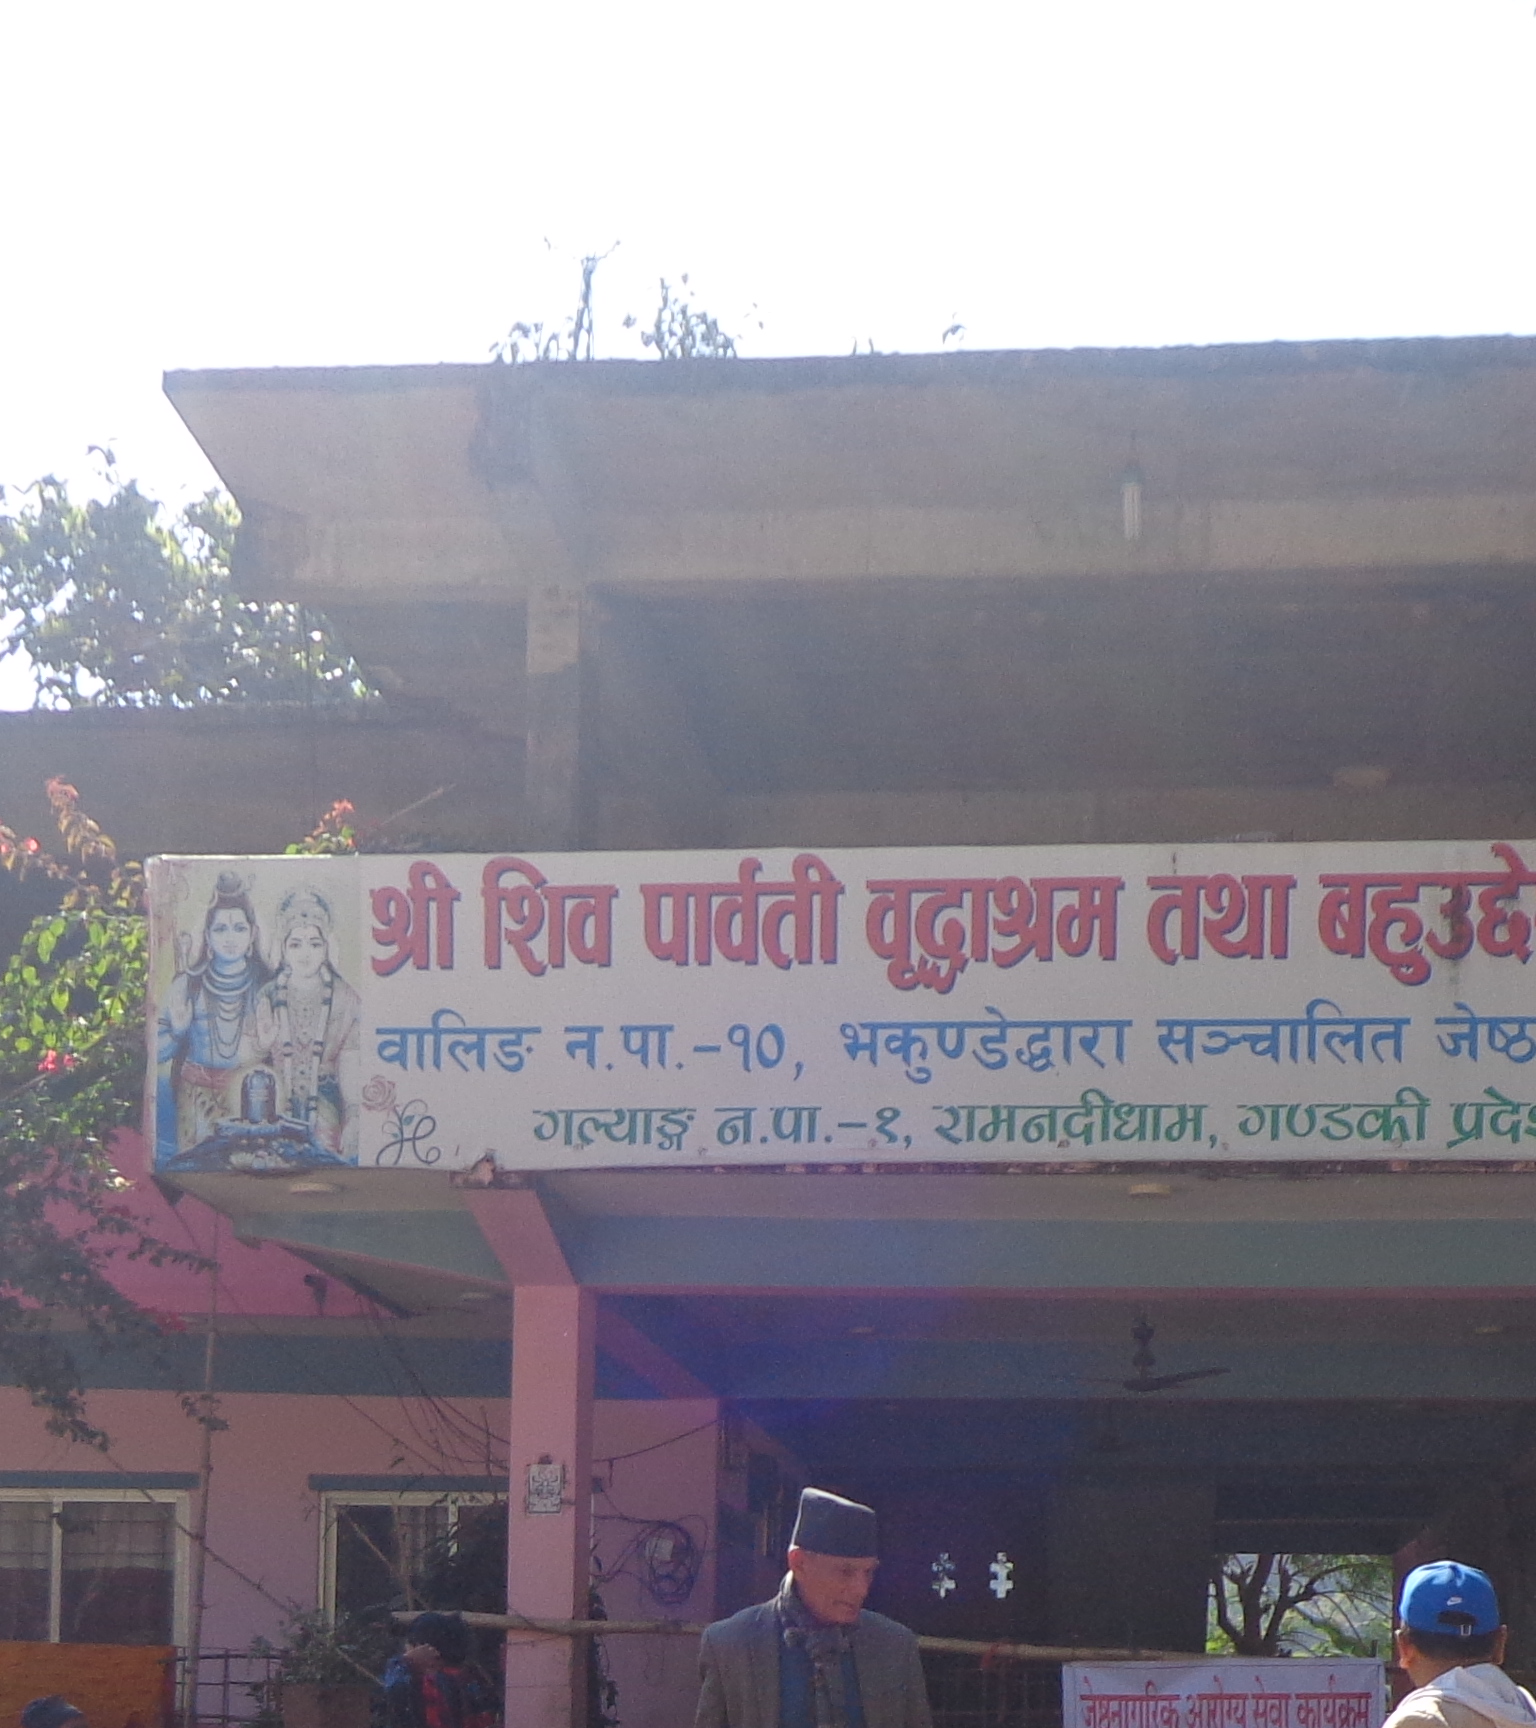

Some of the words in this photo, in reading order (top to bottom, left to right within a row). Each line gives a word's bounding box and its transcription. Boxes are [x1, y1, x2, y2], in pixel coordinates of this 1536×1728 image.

[369, 860, 461, 976] श्री
[481, 856, 619, 977] शिव
[639, 853, 845, 970] पार्वती
[1146, 873, 1297, 965] तथा
[1156, 998, 1412, 1064] सञ्चालित
[1238, 1086, 1430, 1142] गण्डकी
